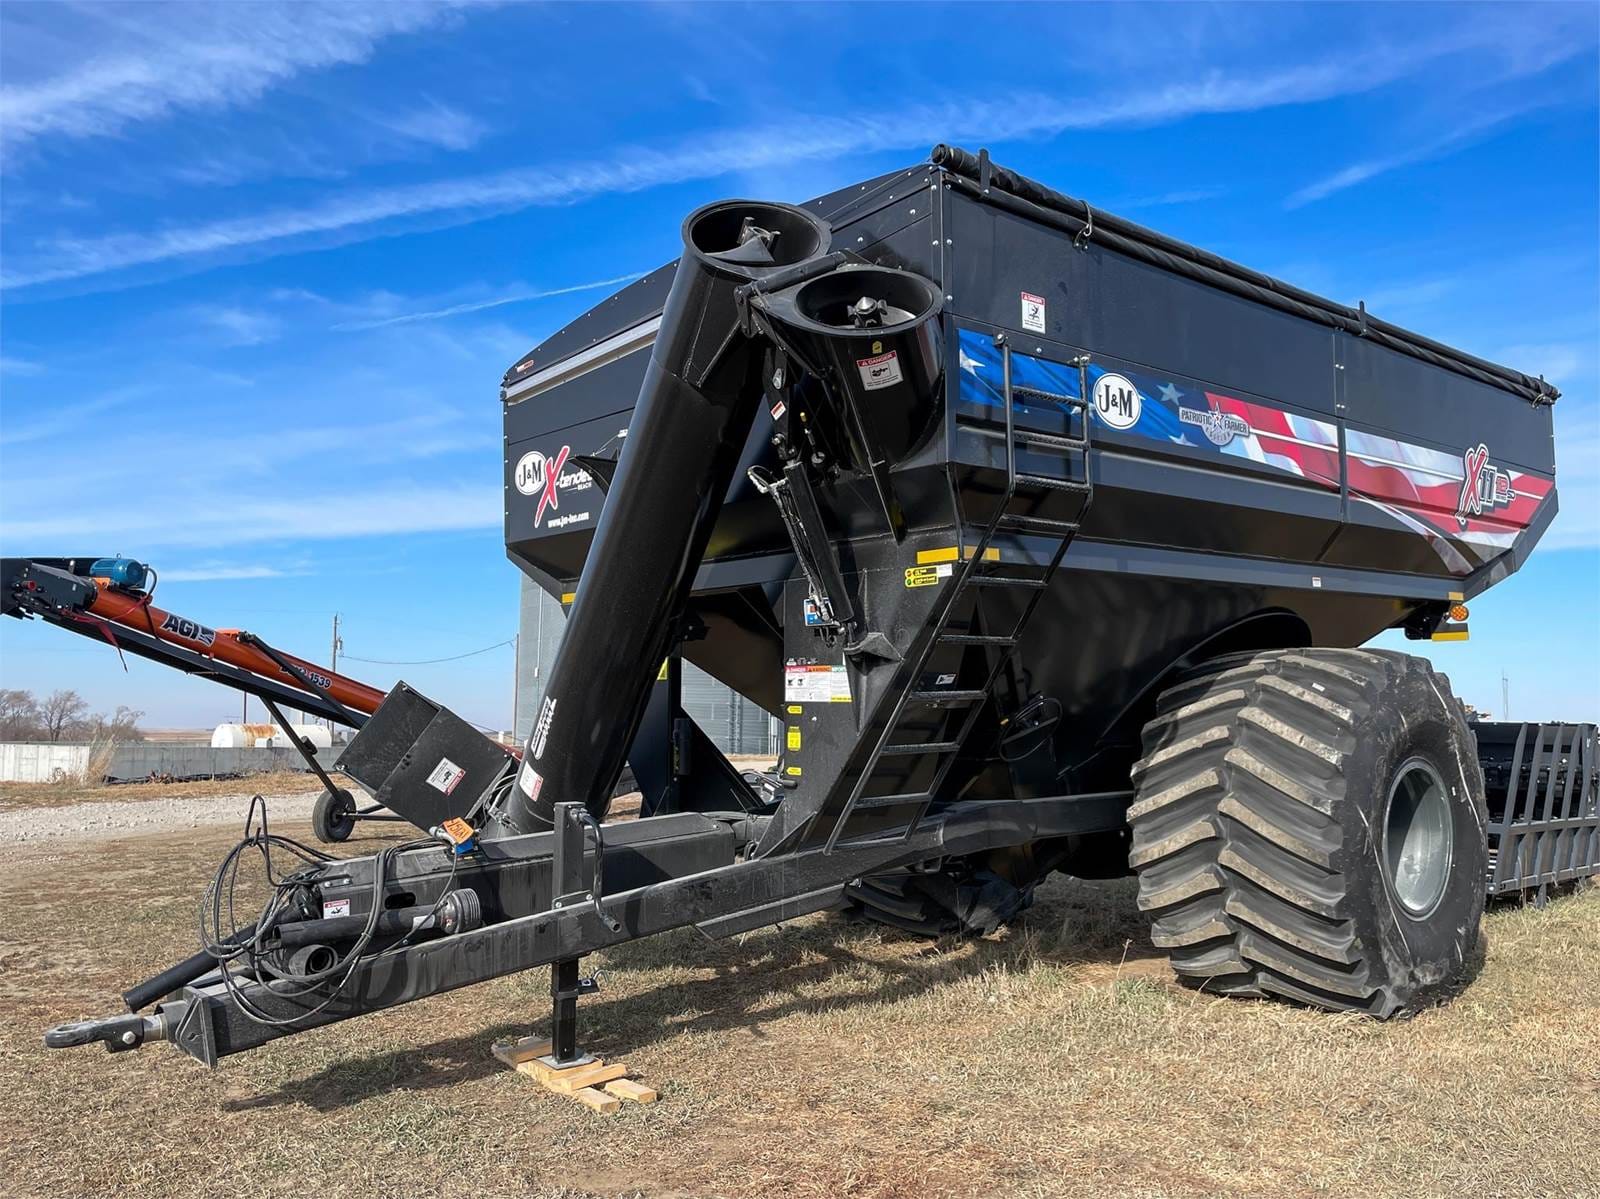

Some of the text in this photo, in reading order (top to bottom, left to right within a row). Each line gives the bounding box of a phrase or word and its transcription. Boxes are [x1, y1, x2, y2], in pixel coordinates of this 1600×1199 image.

[868, 354, 893, 365] DANGER
[1098, 384, 1133, 418] J&M
[1181, 409, 1247, 433] PATRIOTIC FARMER
[518, 460, 542, 487] J&M
[161, 613, 200, 641] AGI
[310, 671, 333, 689] 1539
